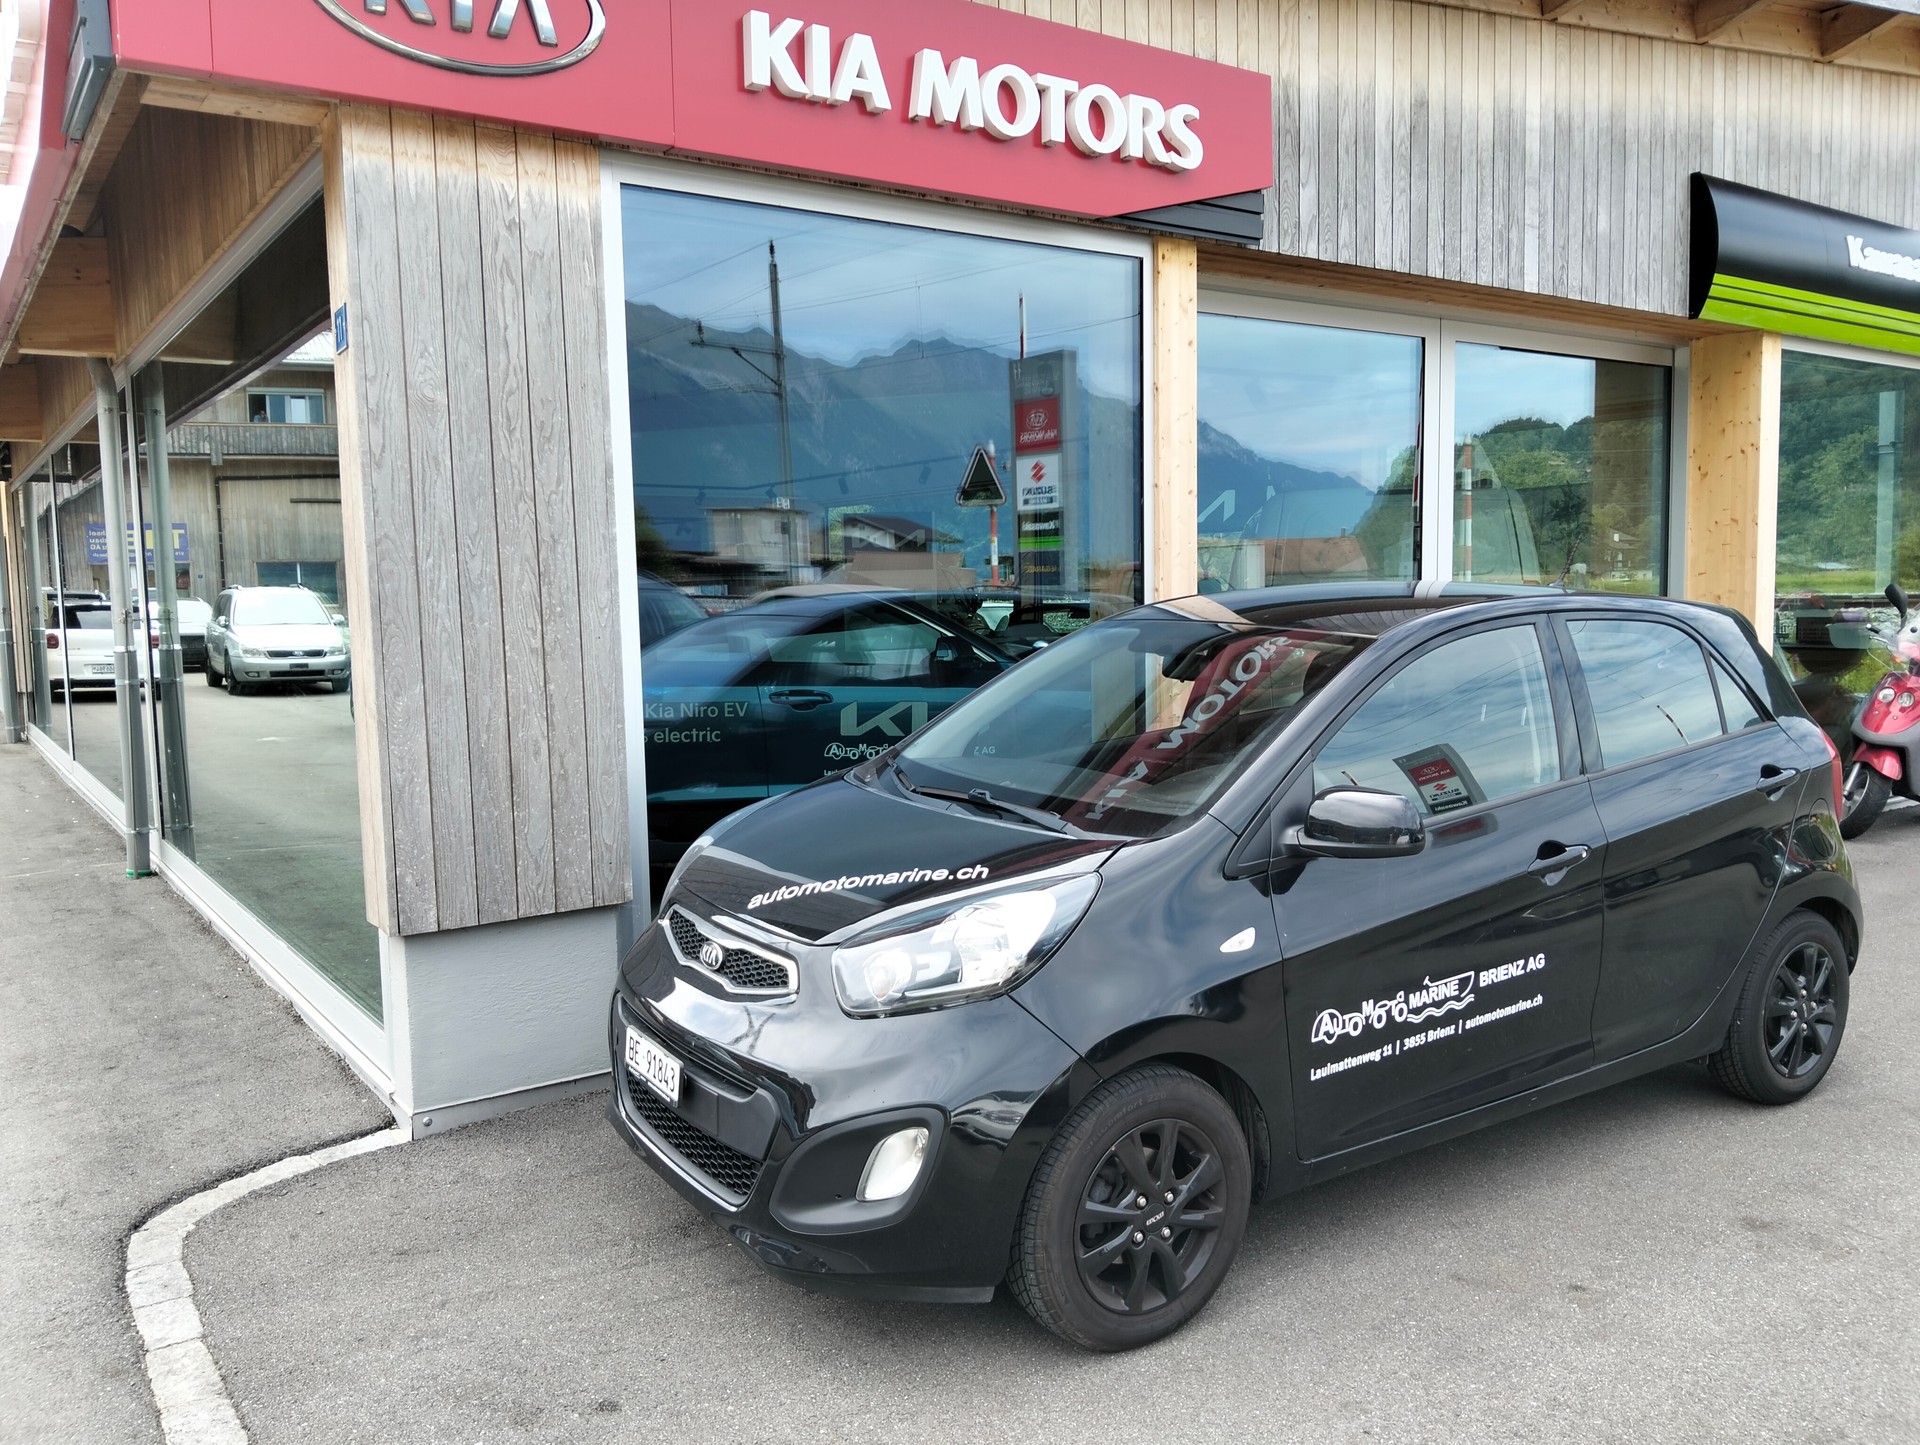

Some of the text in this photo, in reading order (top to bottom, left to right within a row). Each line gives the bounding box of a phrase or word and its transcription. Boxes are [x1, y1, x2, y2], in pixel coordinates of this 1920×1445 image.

[742, 10, 1203, 172] KIA MOTORS
[645, 702, 748, 718] Kia Niro EV
[654, 727, 721, 743] electric
[747, 865, 990, 910] automotomarine.ch
[702, 945, 716, 966] KIA
[1408, 980, 1459, 1009] MARINE
[1479, 959, 1525, 988] BRIENZ
[1526, 953, 1546, 973] AG
[1310, 1047, 1382, 1082] Lauimattenweg
[1403, 1033, 1426, 1051] 3855
[1427, 1025, 1456, 1043] Brienz
[1465, 993, 1543, 1031] automotomarine.ch
[628, 1036, 641, 1066] BE
[646, 1050, 676, 1093] 91843
[1147, 1091, 1167, 1102] 220
